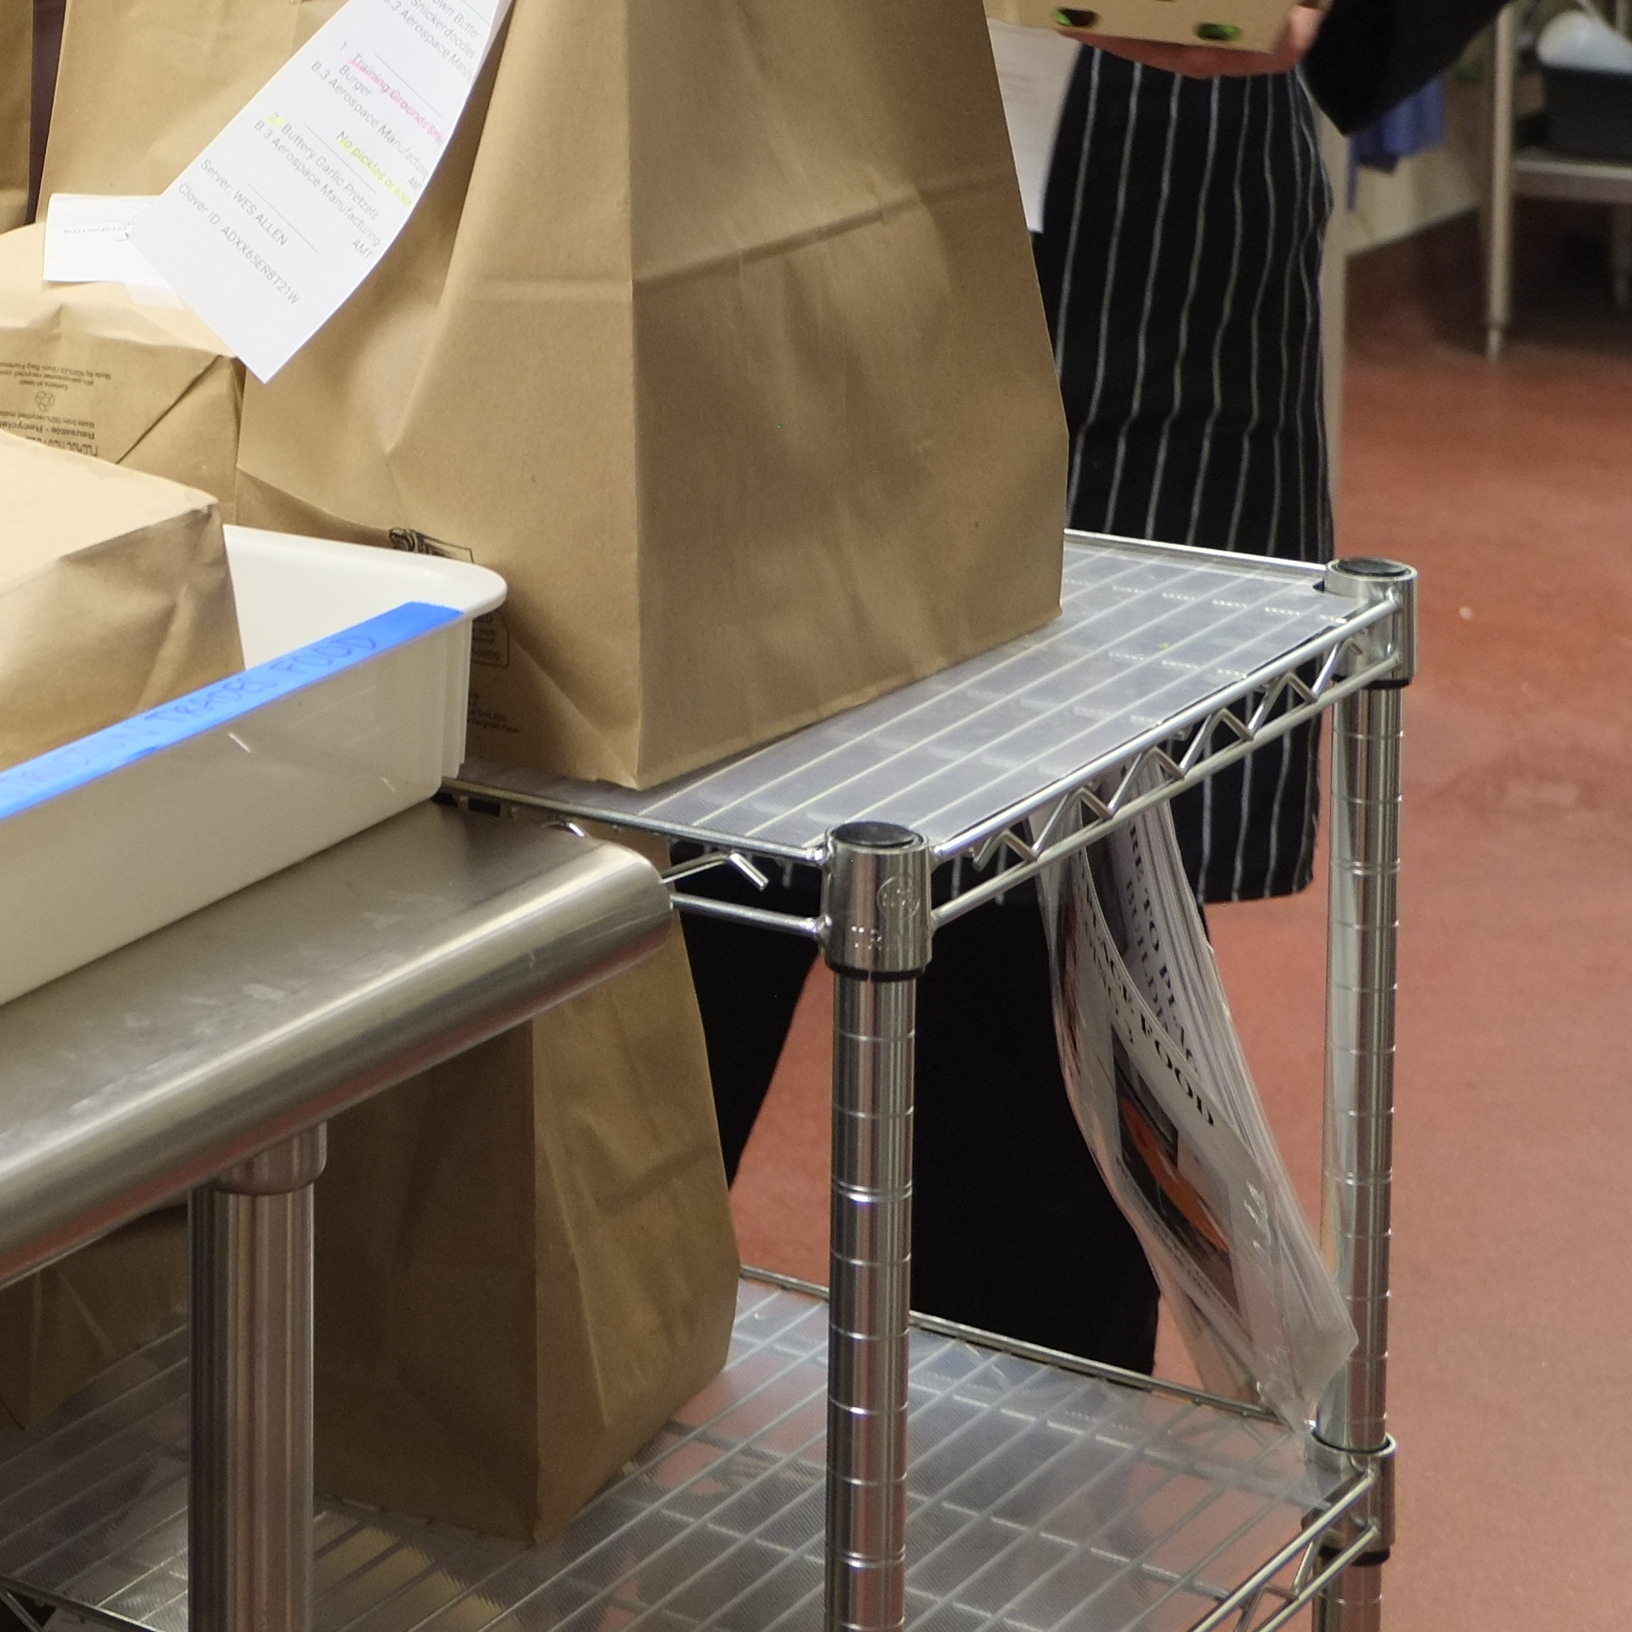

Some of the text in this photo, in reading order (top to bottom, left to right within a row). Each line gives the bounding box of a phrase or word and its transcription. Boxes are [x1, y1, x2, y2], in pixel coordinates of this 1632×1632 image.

[400, 8, 450, 59] Aerospace
[454, 12, 480, 39] Butter
[310, 60, 330, 81] B.3
[328, 76, 379, 129] Aerospace
[339, 64, 372, 98] Burger
[350, 52, 391, 94] Training
[389, 89, 429, 129] Grounds
[281, 122, 316, 161] Buttery
[315, 156, 345, 187] Garlic
[343, 182, 380, 220] Pretzels
[337, 130, 353, 148] No
[352, 144, 385, 181] pickles
[178, 182, 209, 215] Clover
[207, 213, 222, 227] ID:
[200, 159, 288, 246] Server: WES ALLEN
[253, 119, 382, 248] B.3 Aerospace Manufacturing
[351, 238, 373, 260] AMT
[271, 631, 379, 674] FOOD
[1138, 1013, 1216, 1129] FOOD
